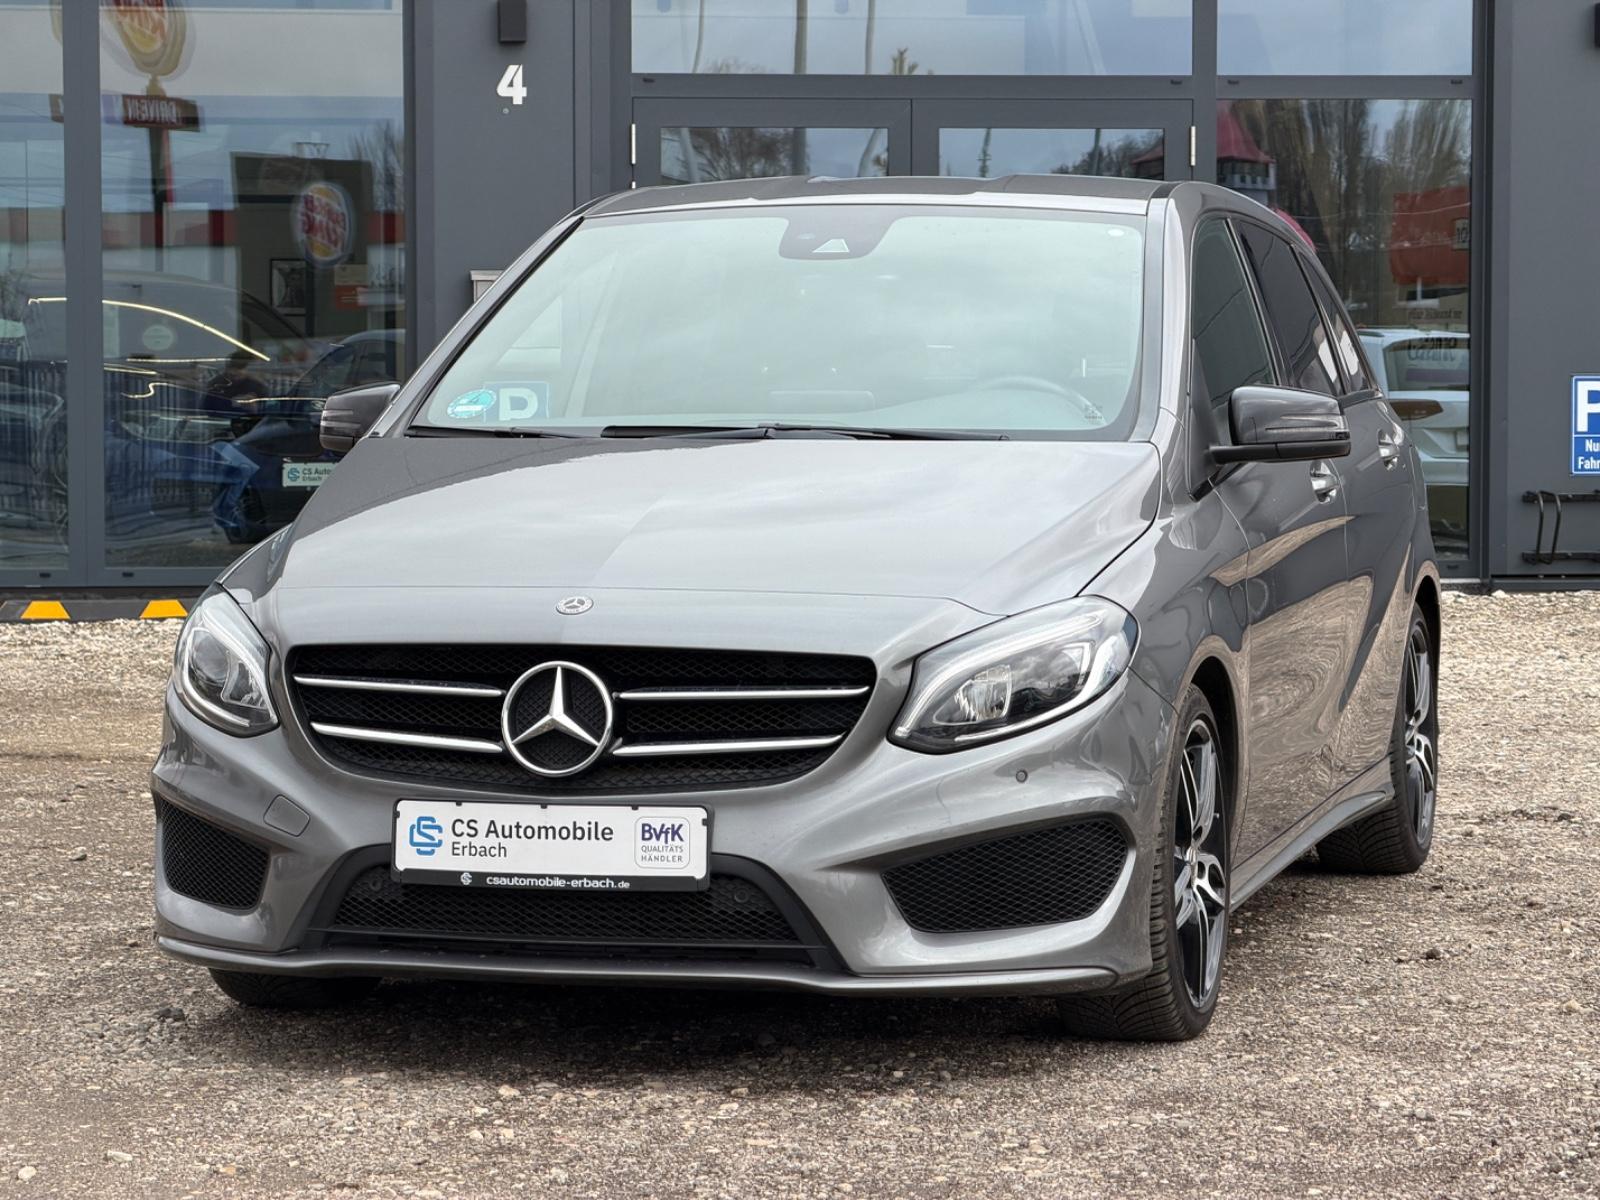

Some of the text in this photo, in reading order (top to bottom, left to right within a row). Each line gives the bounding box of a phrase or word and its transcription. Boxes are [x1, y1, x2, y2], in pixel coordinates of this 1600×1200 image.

[497, 64, 527, 105] 4
[1577, 380, 1600, 432] P
[452, 818, 614, 841] CS Automobile
[452, 841, 507, 857] Erbach
[641, 844, 684, 853] QUALITÄTS
[641, 854, 684, 863] HÄNDLER
[486, 875, 630, 889] csautomobile-erbach.de
